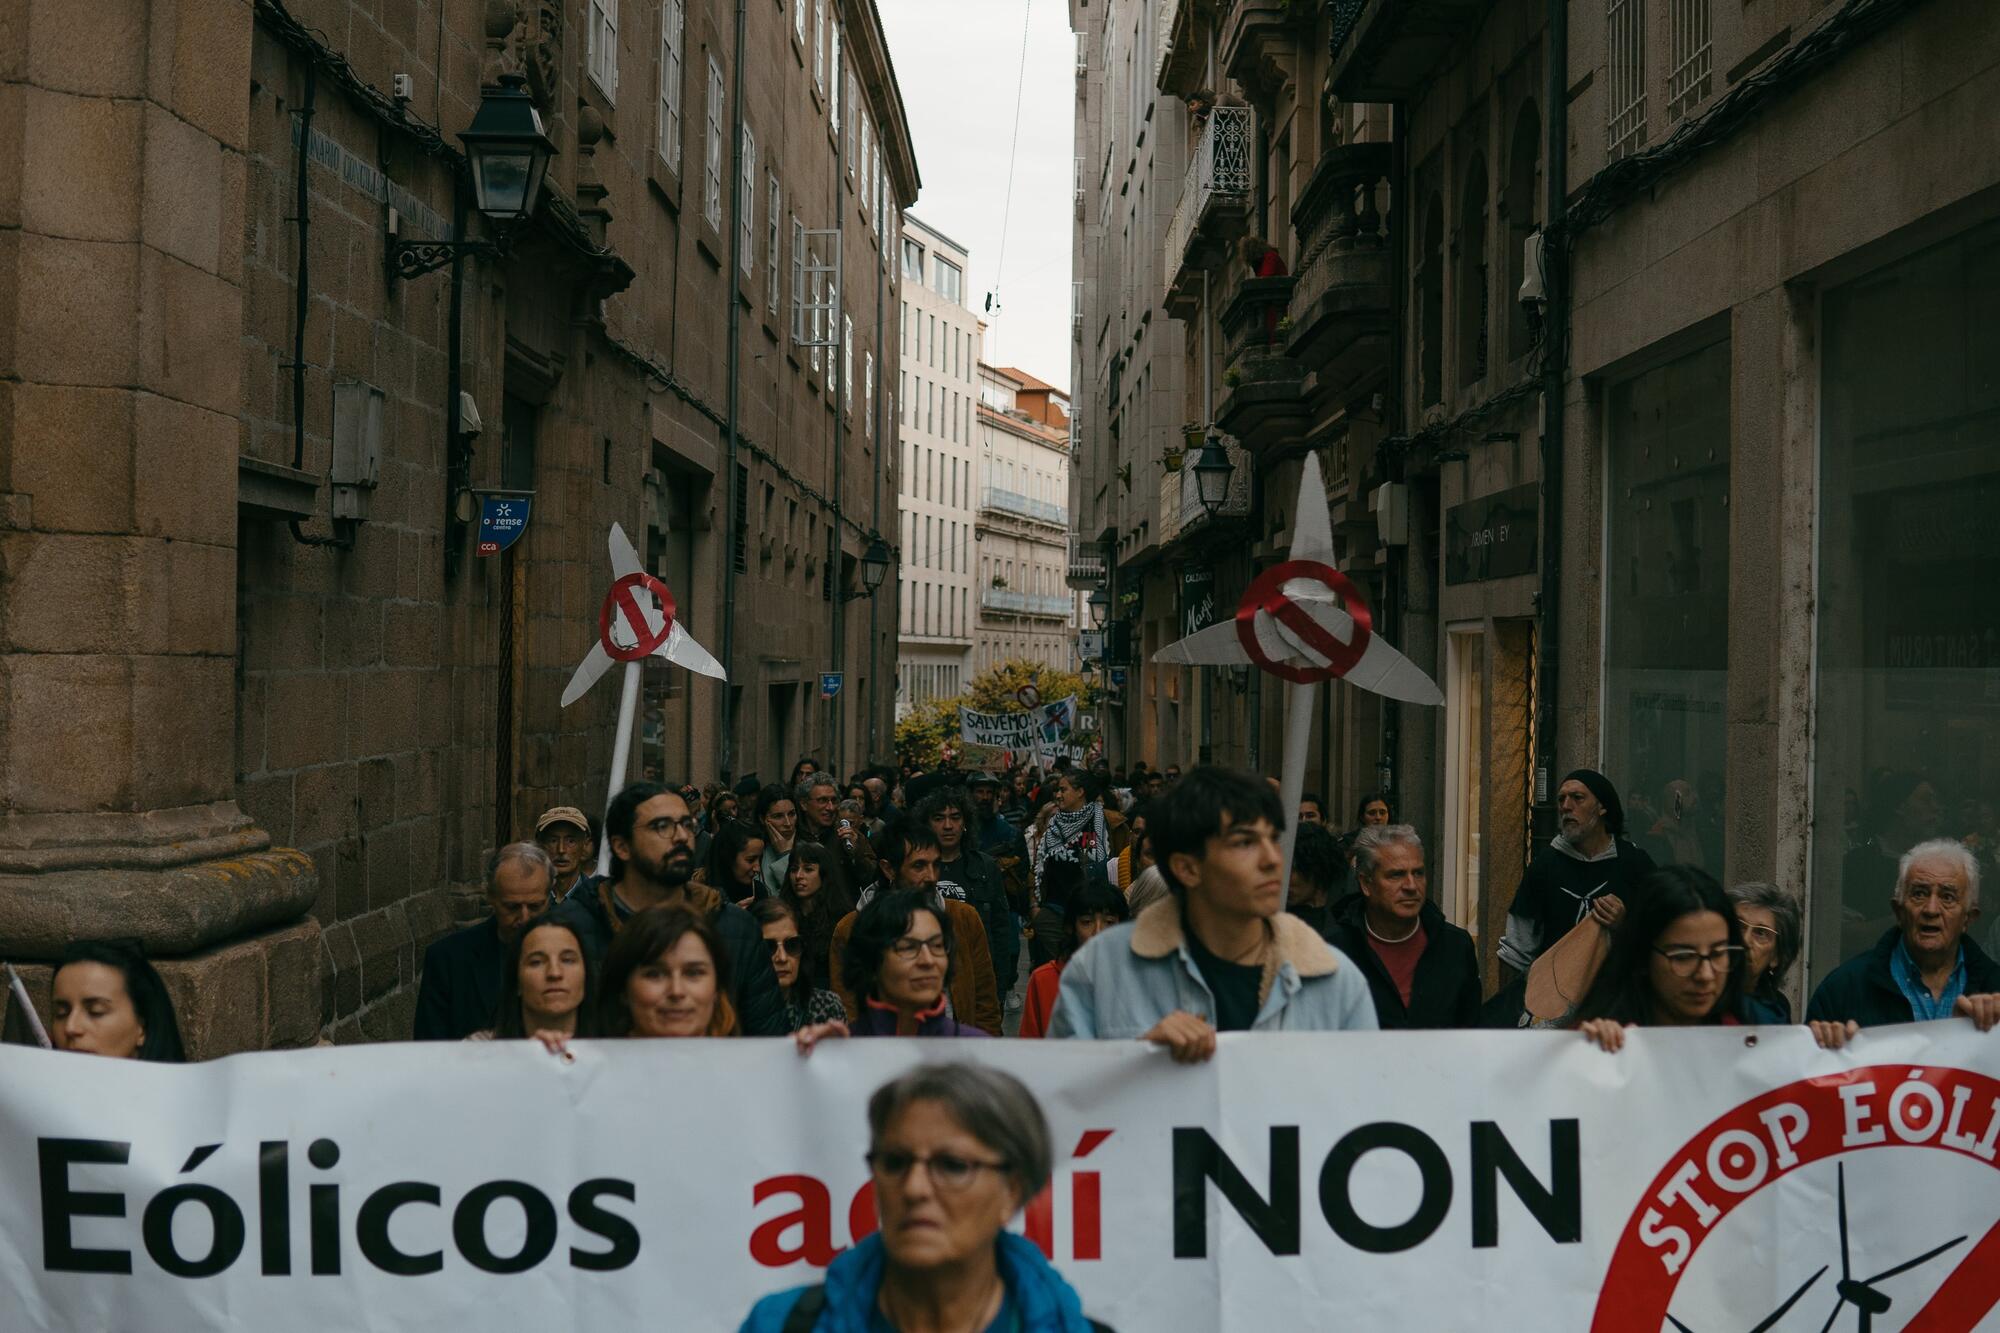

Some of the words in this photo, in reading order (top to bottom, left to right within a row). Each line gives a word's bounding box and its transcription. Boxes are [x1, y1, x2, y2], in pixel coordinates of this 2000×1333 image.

[483, 518, 522, 526] orense
[481, 543, 497, 551] cca
[1467, 528, 1494, 547] ARMEN
[38, 1138, 641, 1278] Eólicos
[750, 1128, 1116, 1268] aí
[1172, 1118, 1582, 1259] NON
[1638, 1102, 1810, 1276] STOP
